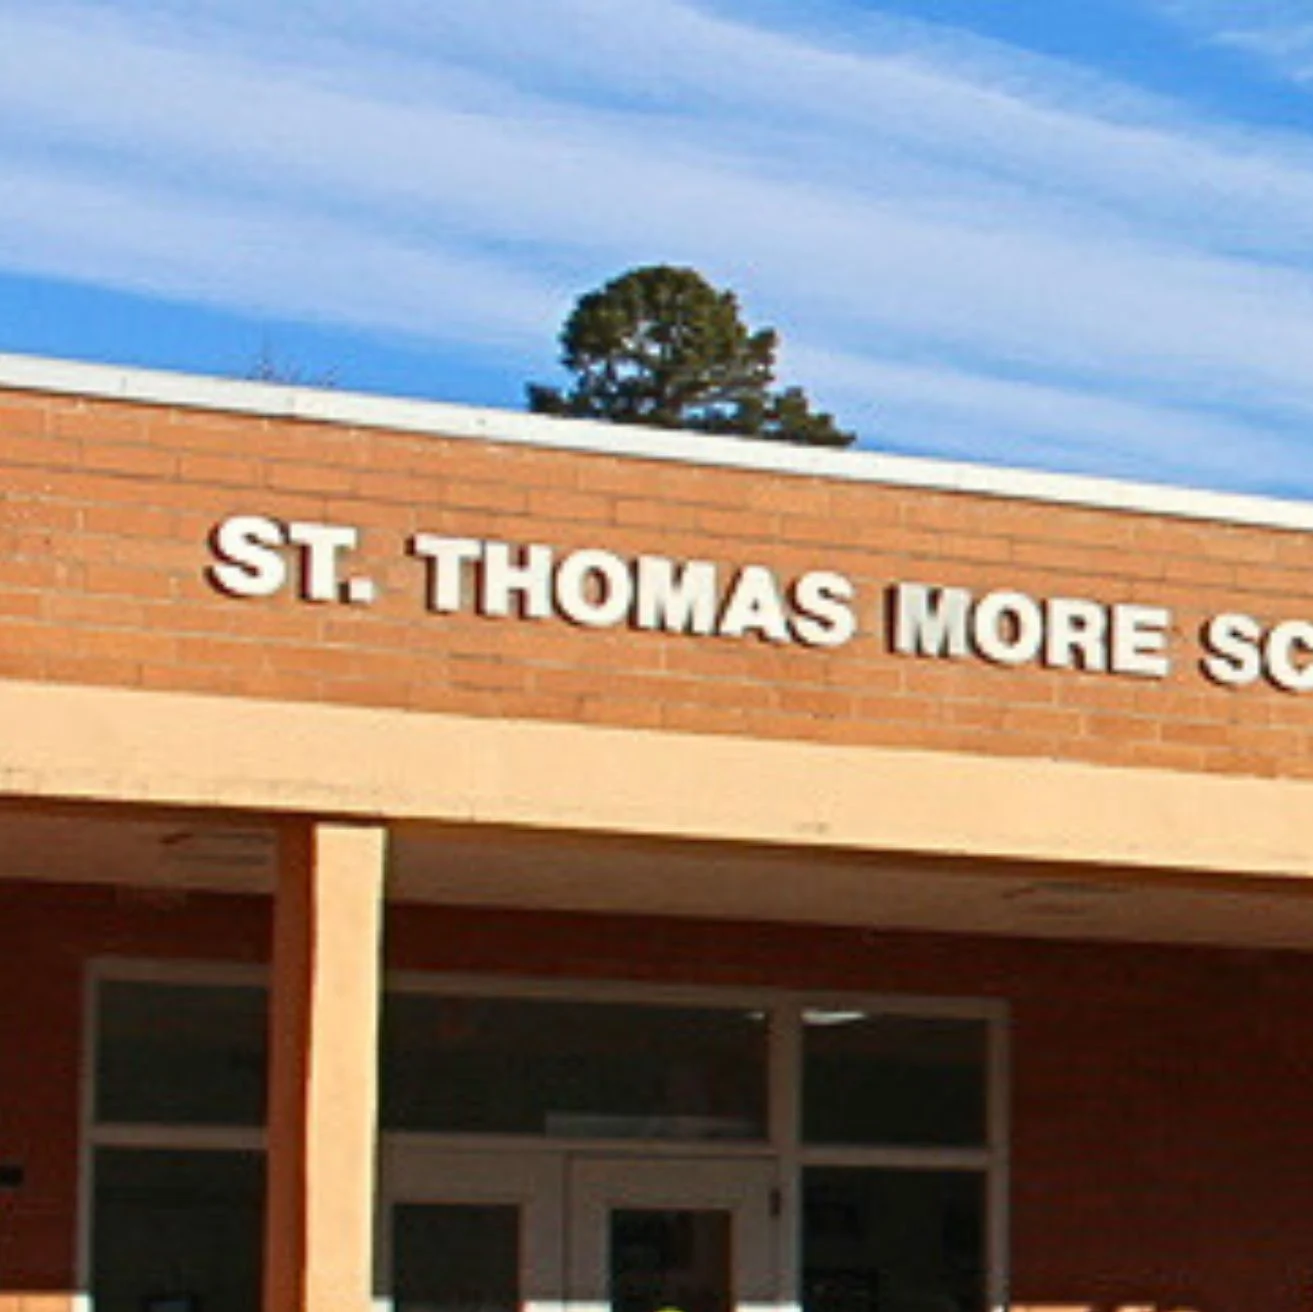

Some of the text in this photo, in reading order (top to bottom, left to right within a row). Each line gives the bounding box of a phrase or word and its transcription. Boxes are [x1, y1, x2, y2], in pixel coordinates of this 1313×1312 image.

[210, 514, 375, 604] ST.
[412, 531, 859, 647] THOMAS
[891, 581, 1171, 678] MORE
